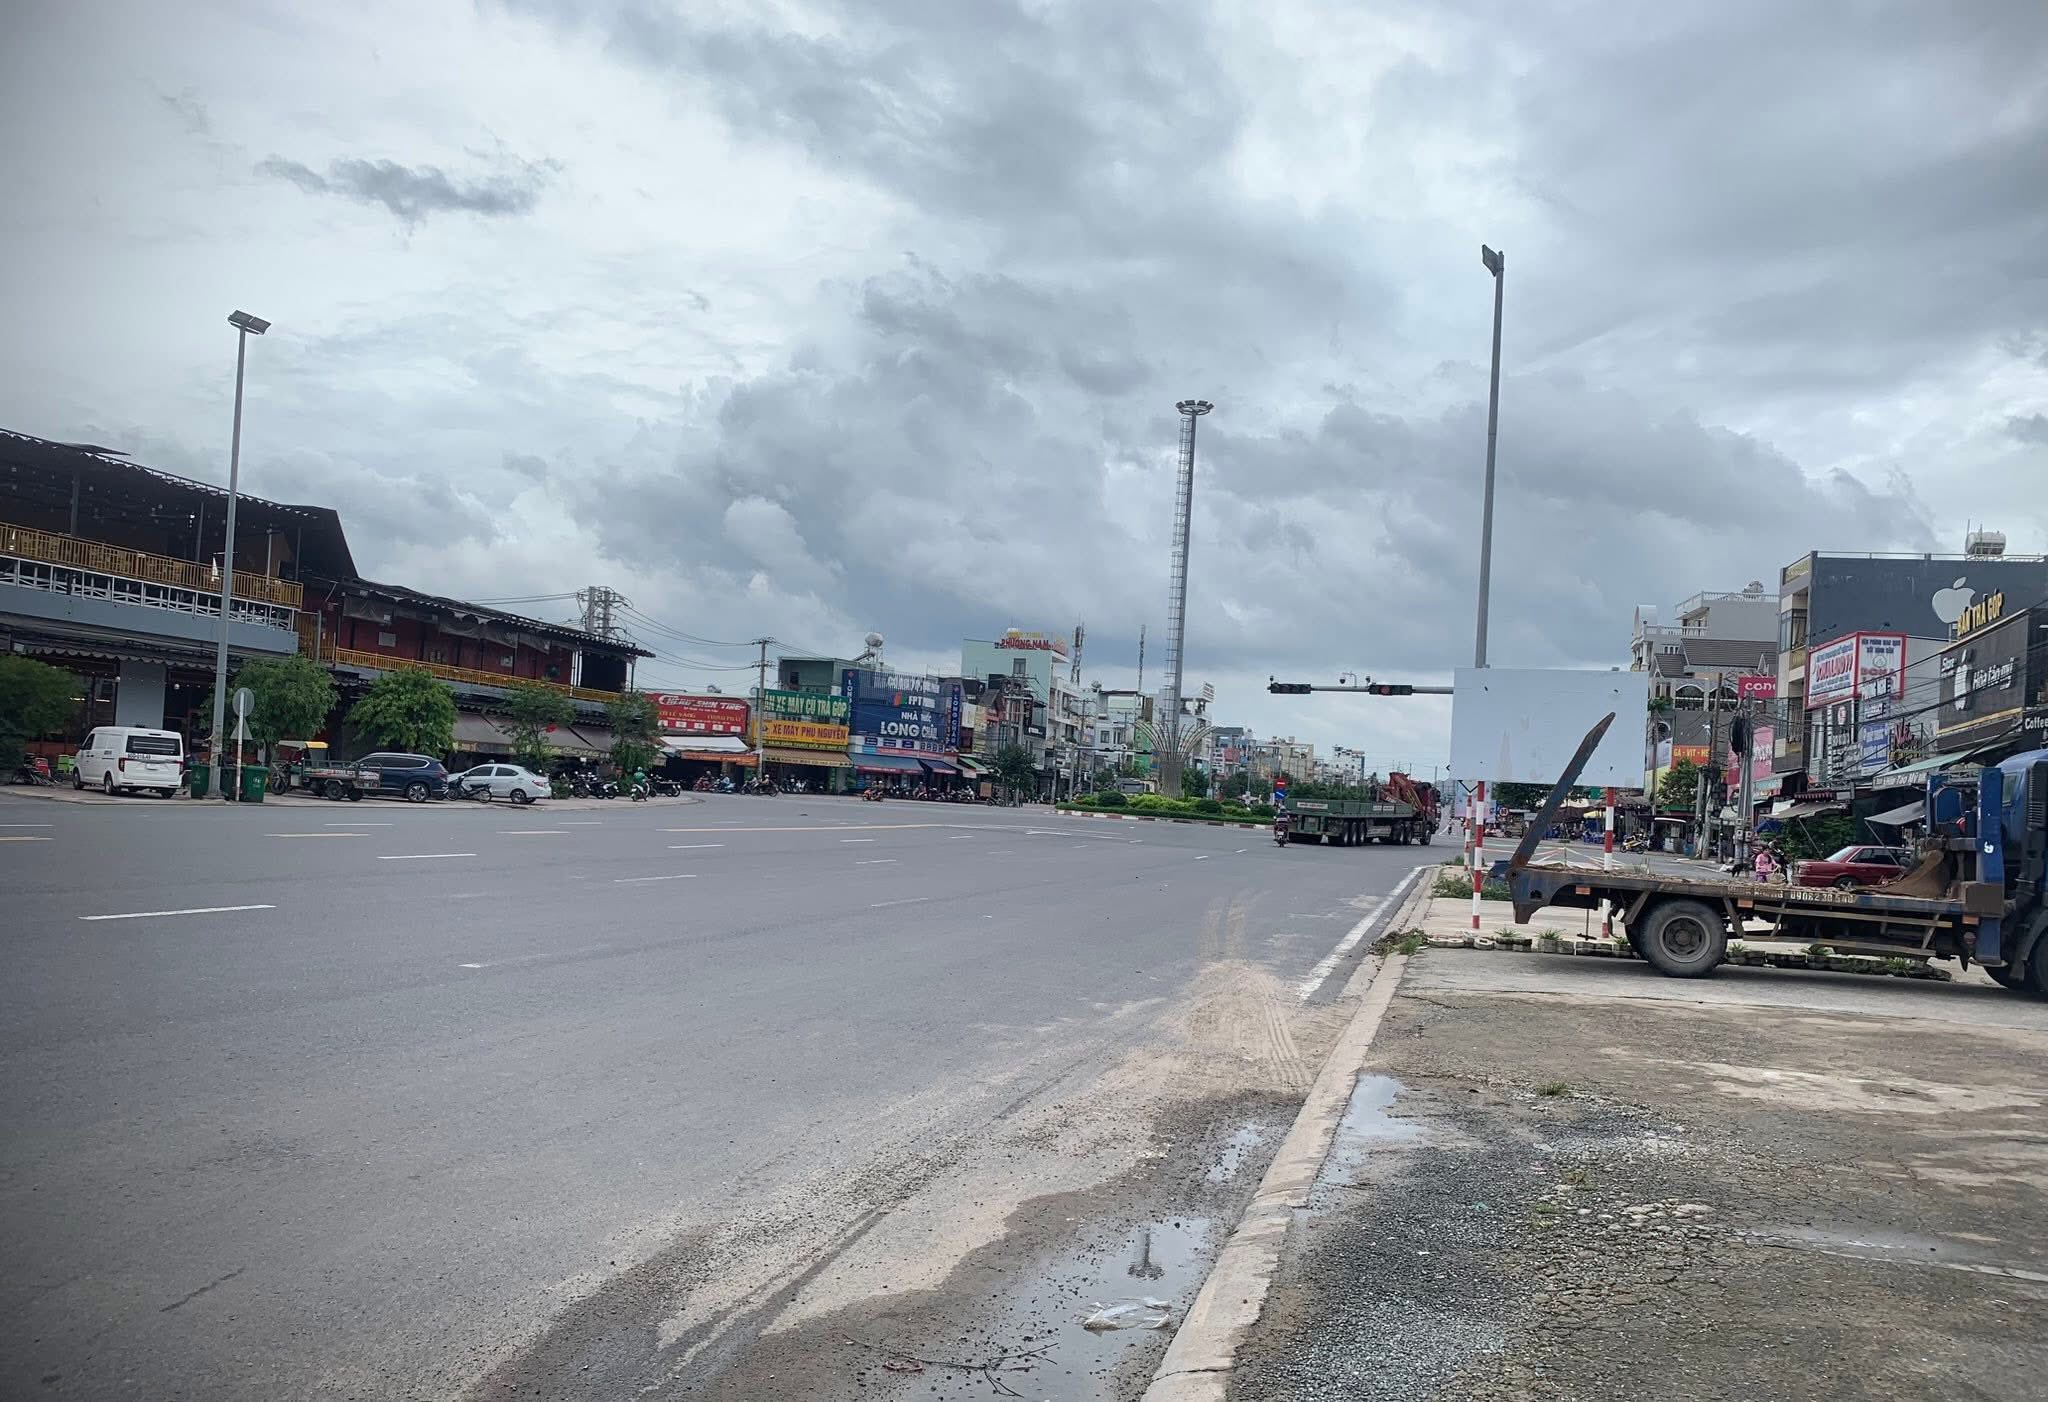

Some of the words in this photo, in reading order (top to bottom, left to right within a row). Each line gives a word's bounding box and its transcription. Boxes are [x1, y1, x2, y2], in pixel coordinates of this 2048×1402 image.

[776, 695, 787, 712] XE
[787, 694, 804, 713] MÁY
[832, 698, 847, 718] GÓP
[908, 695, 923, 706] FPT
[772, 724, 782, 735] XE
[880, 721, 919, 737] LONG
